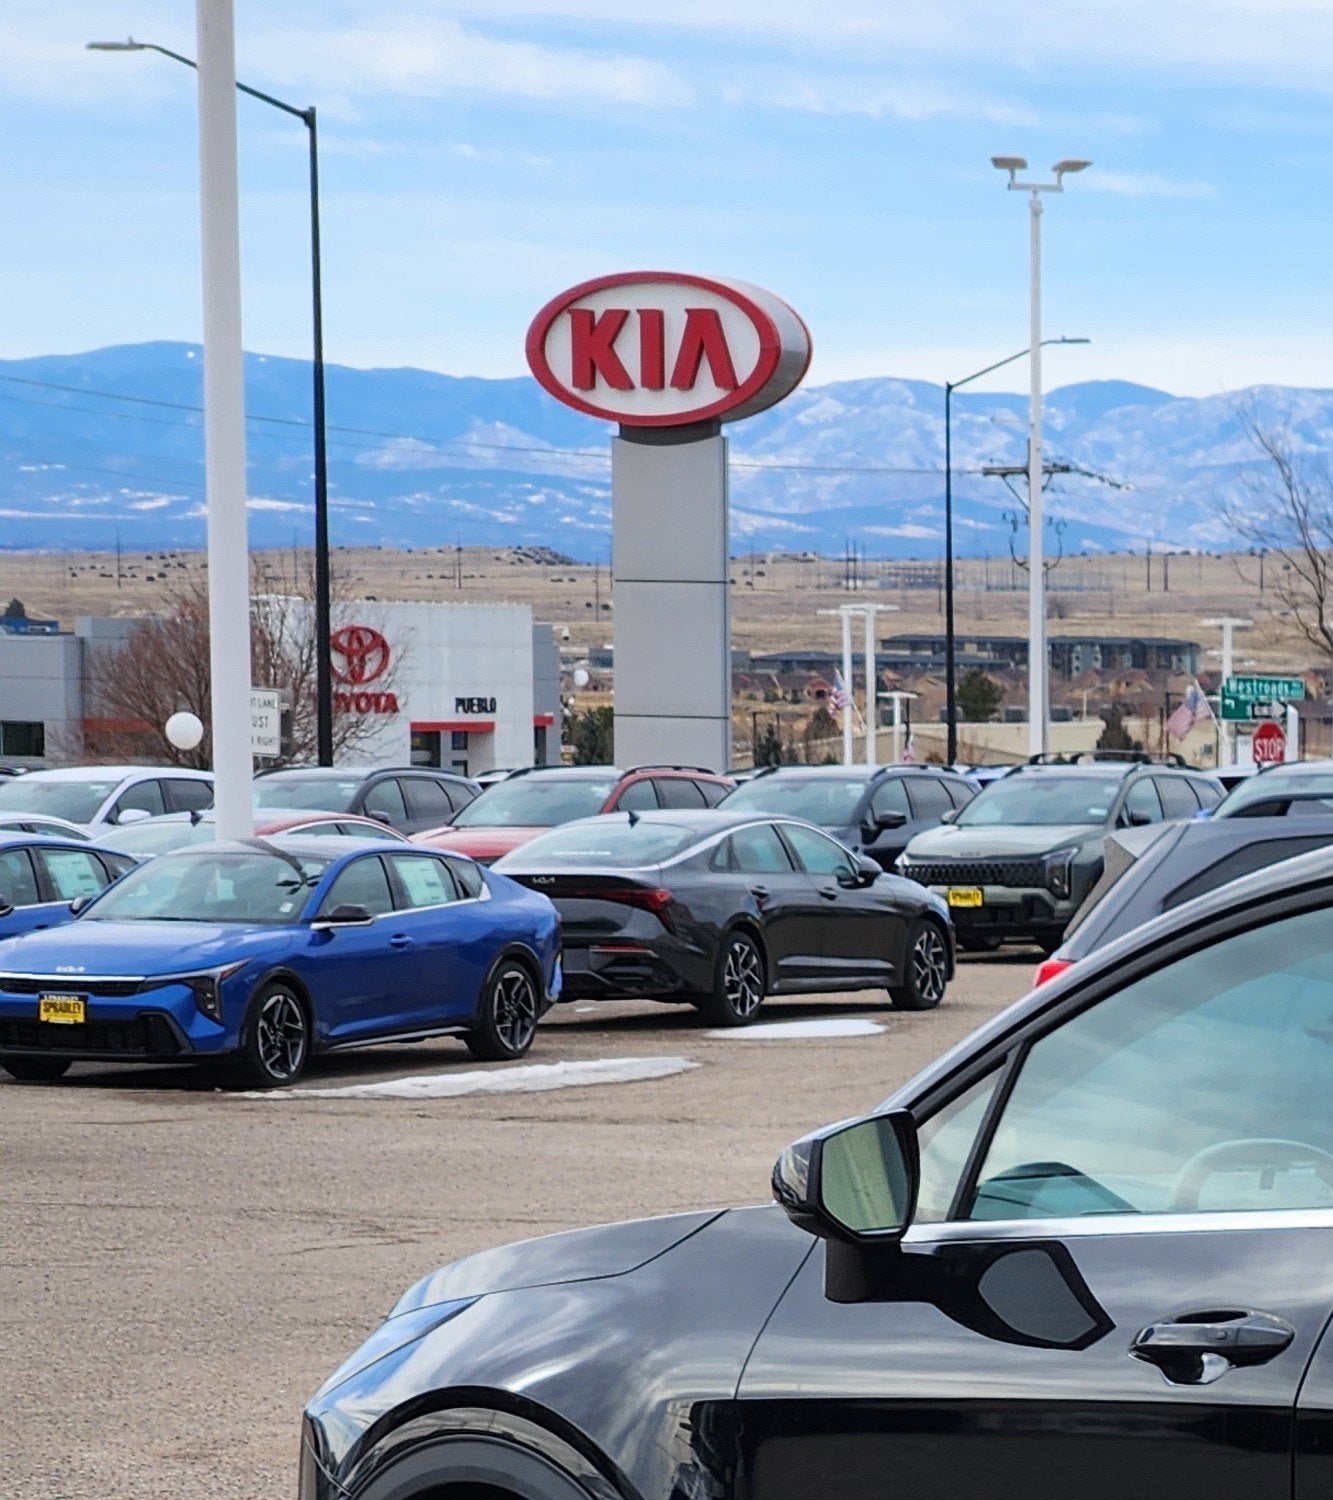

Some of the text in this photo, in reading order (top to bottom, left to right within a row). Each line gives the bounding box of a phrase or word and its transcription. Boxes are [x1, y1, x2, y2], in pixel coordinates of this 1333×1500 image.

[567, 308, 741, 391] KIA
[455, 697, 497, 714] PUEBLO
[1255, 738, 1285, 761] STOP
